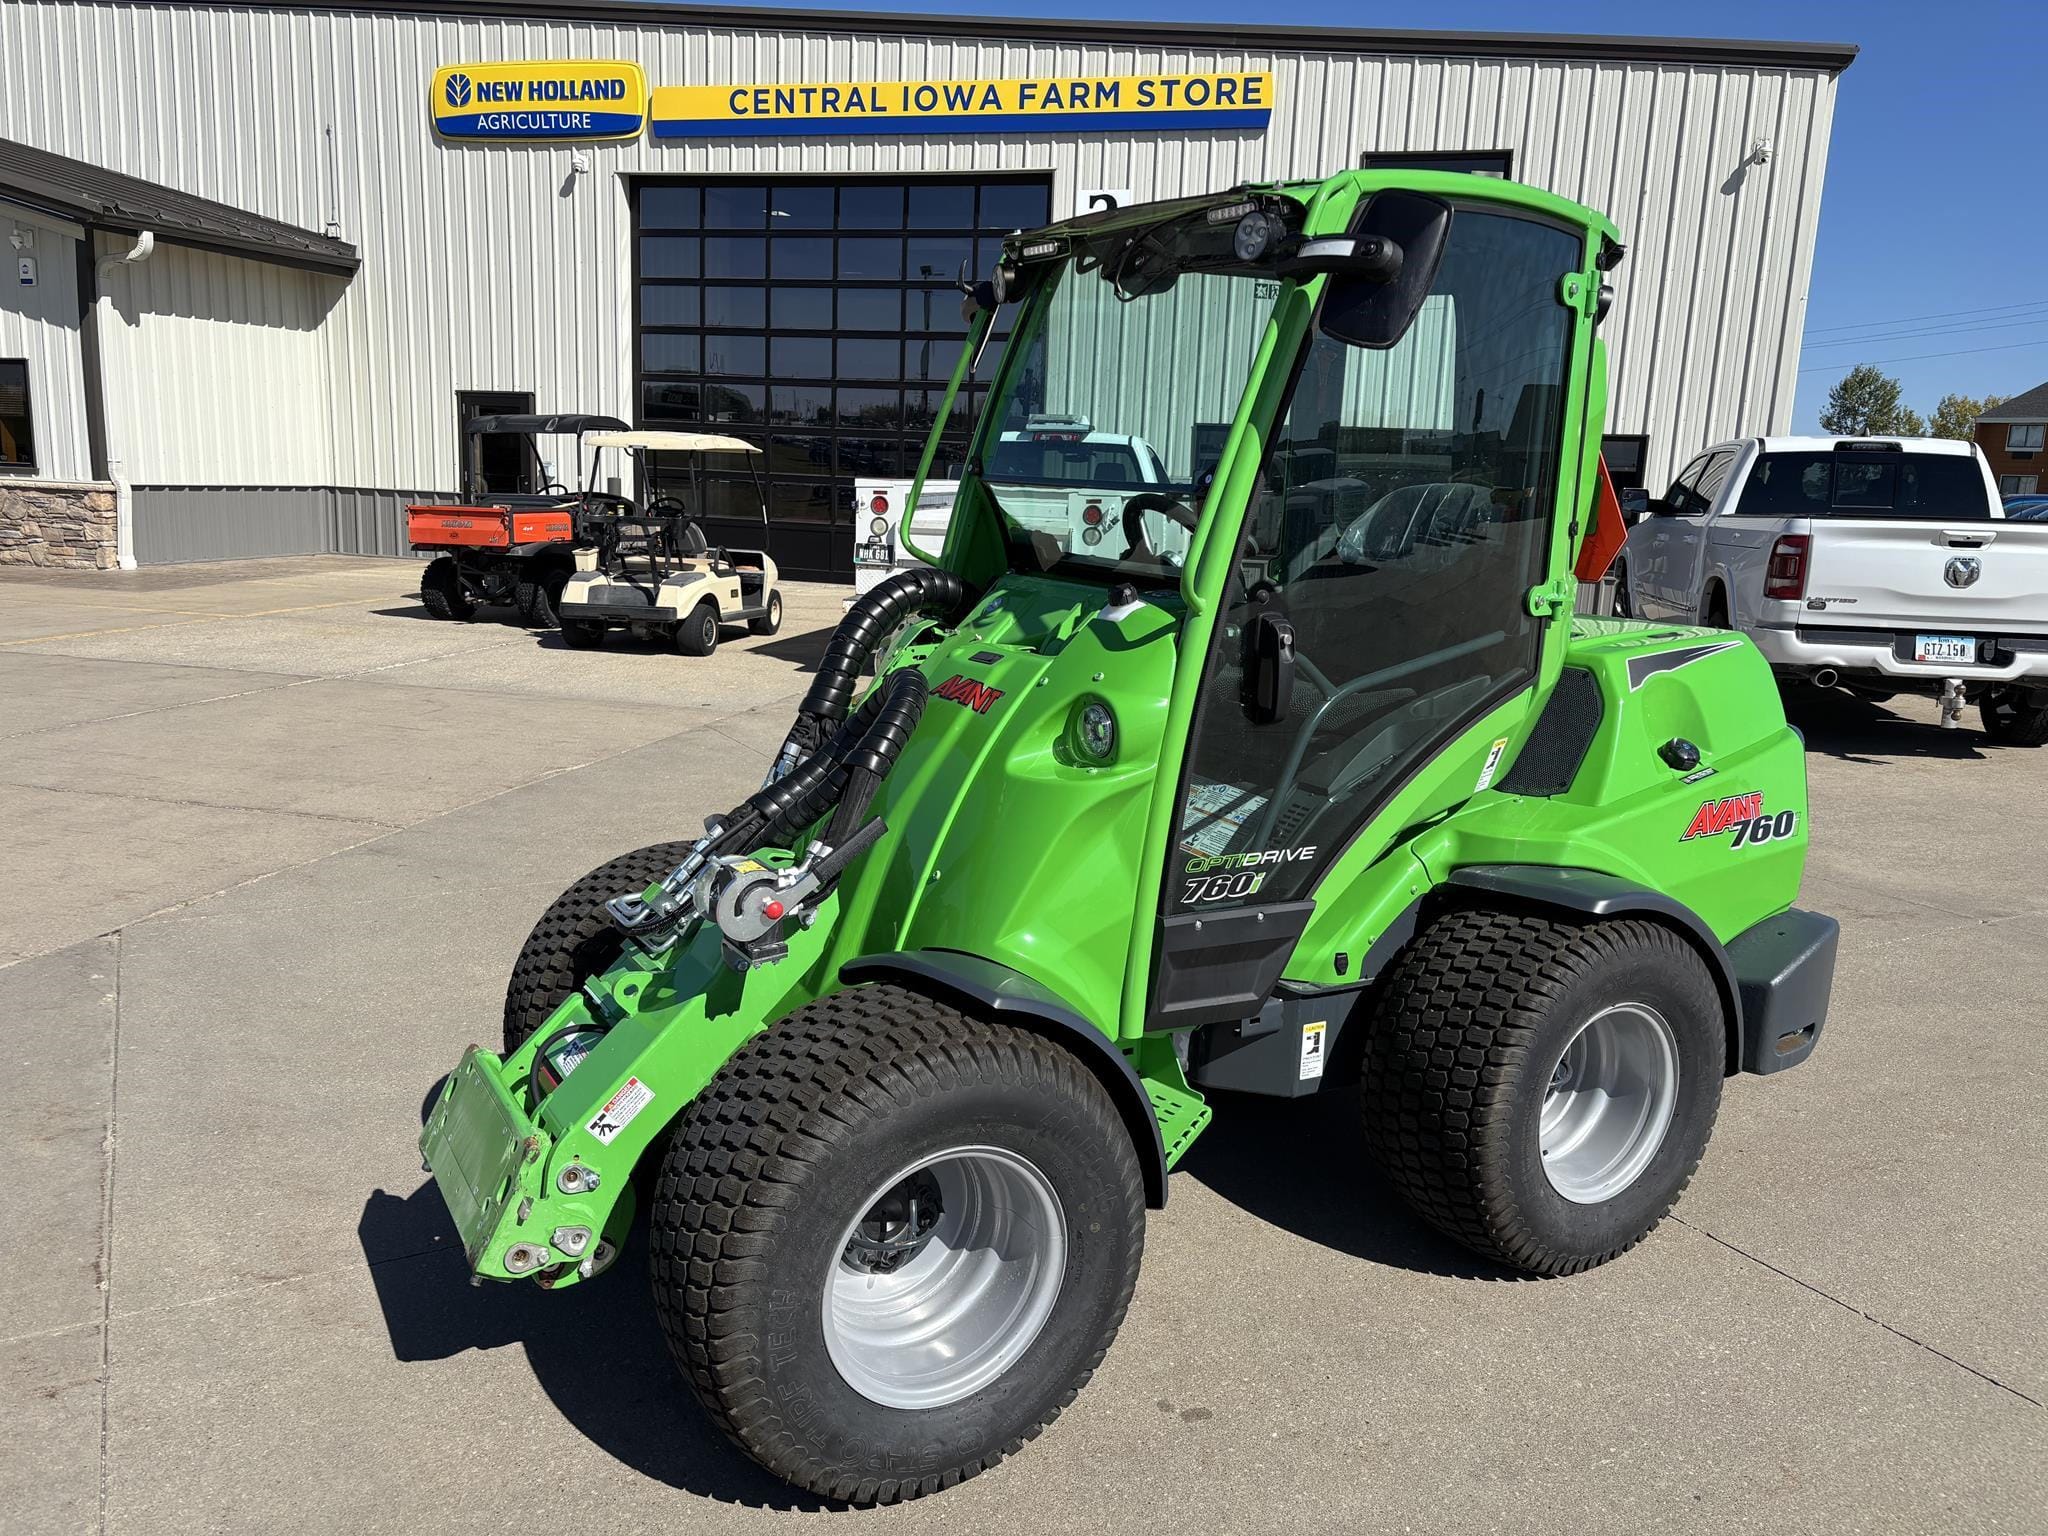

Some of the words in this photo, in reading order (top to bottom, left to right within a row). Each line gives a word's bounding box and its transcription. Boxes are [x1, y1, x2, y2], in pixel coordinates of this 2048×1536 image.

[477, 80, 524, 102] NEW
[528, 79, 626, 101] HOLLAND
[729, 86, 888, 115] CENTRAL
[902, 84, 1003, 112] IOWA
[1018, 81, 1120, 110] FARM
[1136, 76, 1263, 107] STORE
[477, 112, 592, 129] AGRICULTURE
[1924, 643, 1943, 656] GTZ
[928, 674, 1006, 715] AVANT
[1679, 790, 1764, 842] AVANT
[1180, 871, 1267, 904] 760i
[767, 1288, 802, 1376] TECH
[777, 1380, 836, 1450] TURF
